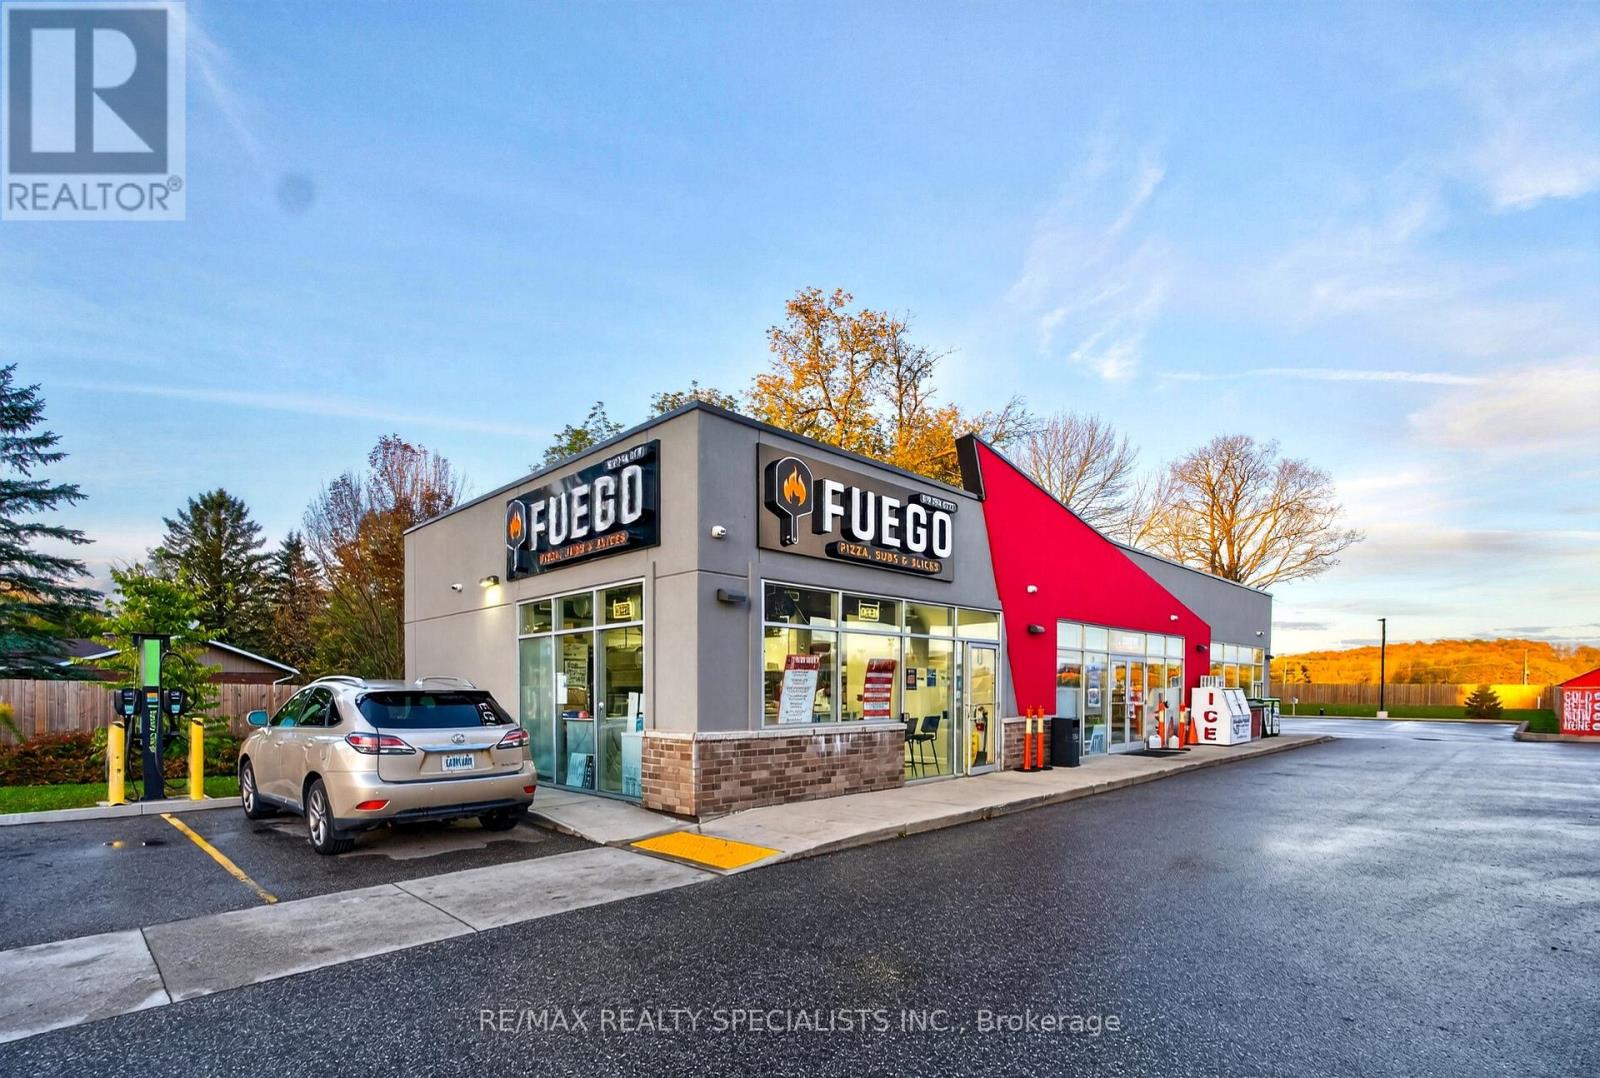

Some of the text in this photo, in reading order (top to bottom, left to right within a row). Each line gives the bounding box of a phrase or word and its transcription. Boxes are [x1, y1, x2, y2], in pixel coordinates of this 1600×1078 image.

[529, 465, 643, 551] FUEGO
[824, 478, 952, 559] FUEGO
[840, 542, 872, 559] PIZZA,
[875, 550, 898, 564] SUBS
[911, 558, 939, 572] SLICES
[1204, 692, 1218, 741] ICE
